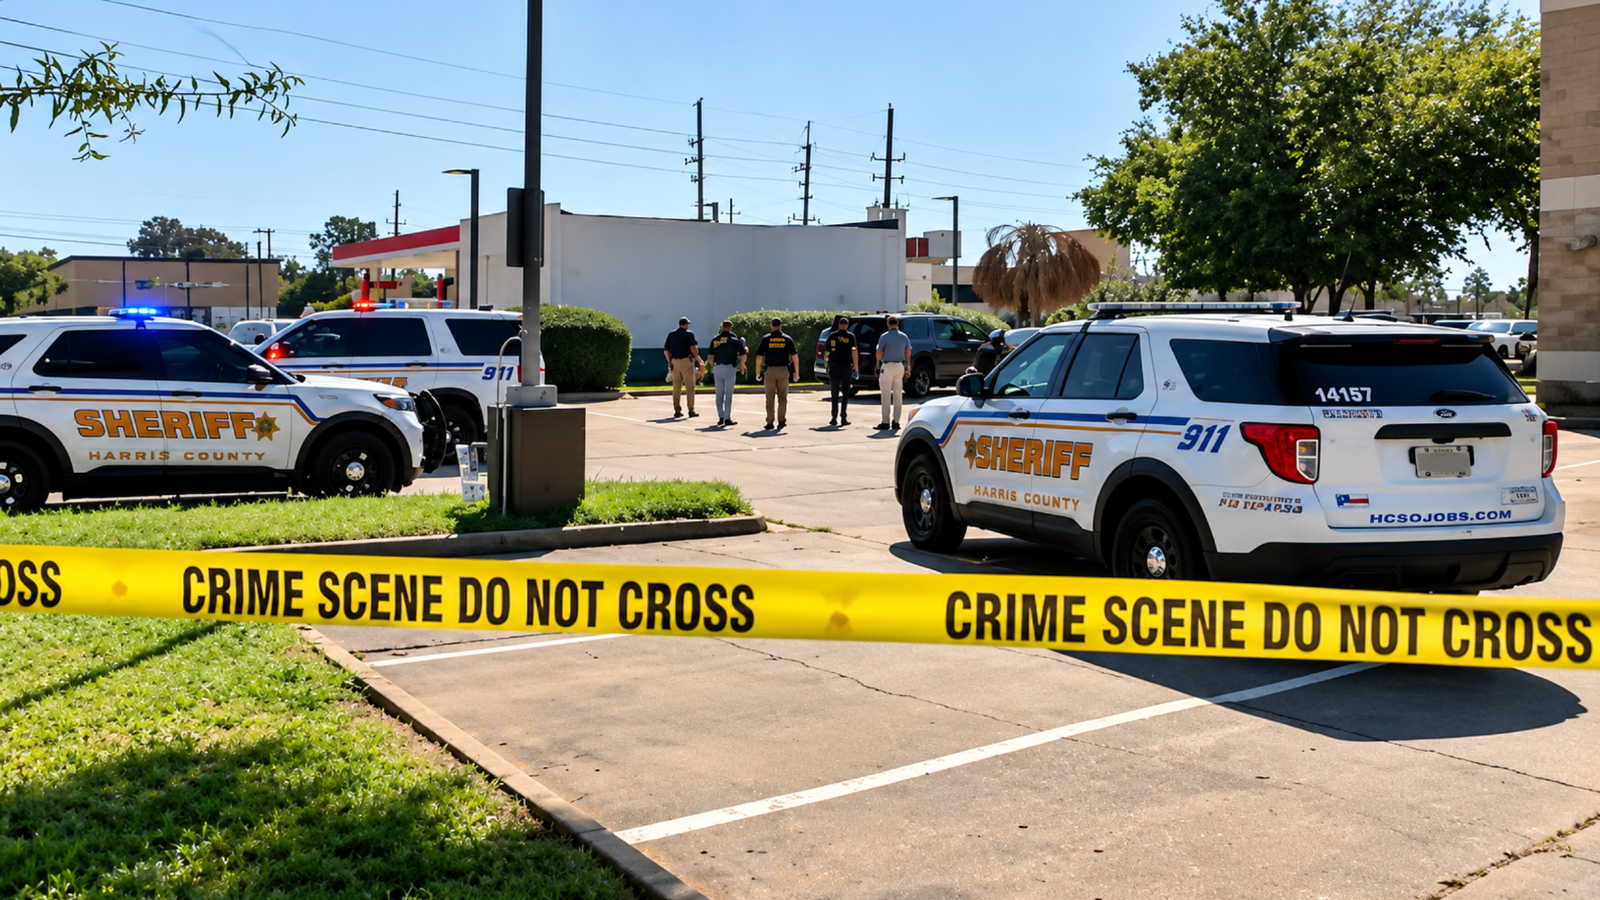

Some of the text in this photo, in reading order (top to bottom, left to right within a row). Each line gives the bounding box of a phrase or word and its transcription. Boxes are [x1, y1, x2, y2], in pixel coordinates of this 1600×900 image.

[481, 366, 514, 381] 911
[1315, 387, 1371, 402] 14157
[74, 409, 256, 439] SHERIFF
[1177, 424, 1231, 453] 911
[89, 451, 266, 461] HARRIS COUNTY
[975, 435, 1093, 480] SHERIFF
[974, 485, 1079, 511] HARRIS COUNTY
[1370, 510, 1512, 523] HCSOJOBS.COM
[183, 566, 754, 633] CRIME SCENE DO NOT CROSS
[945, 591, 1593, 664] CRIME SCENE DO NOT CROSS
